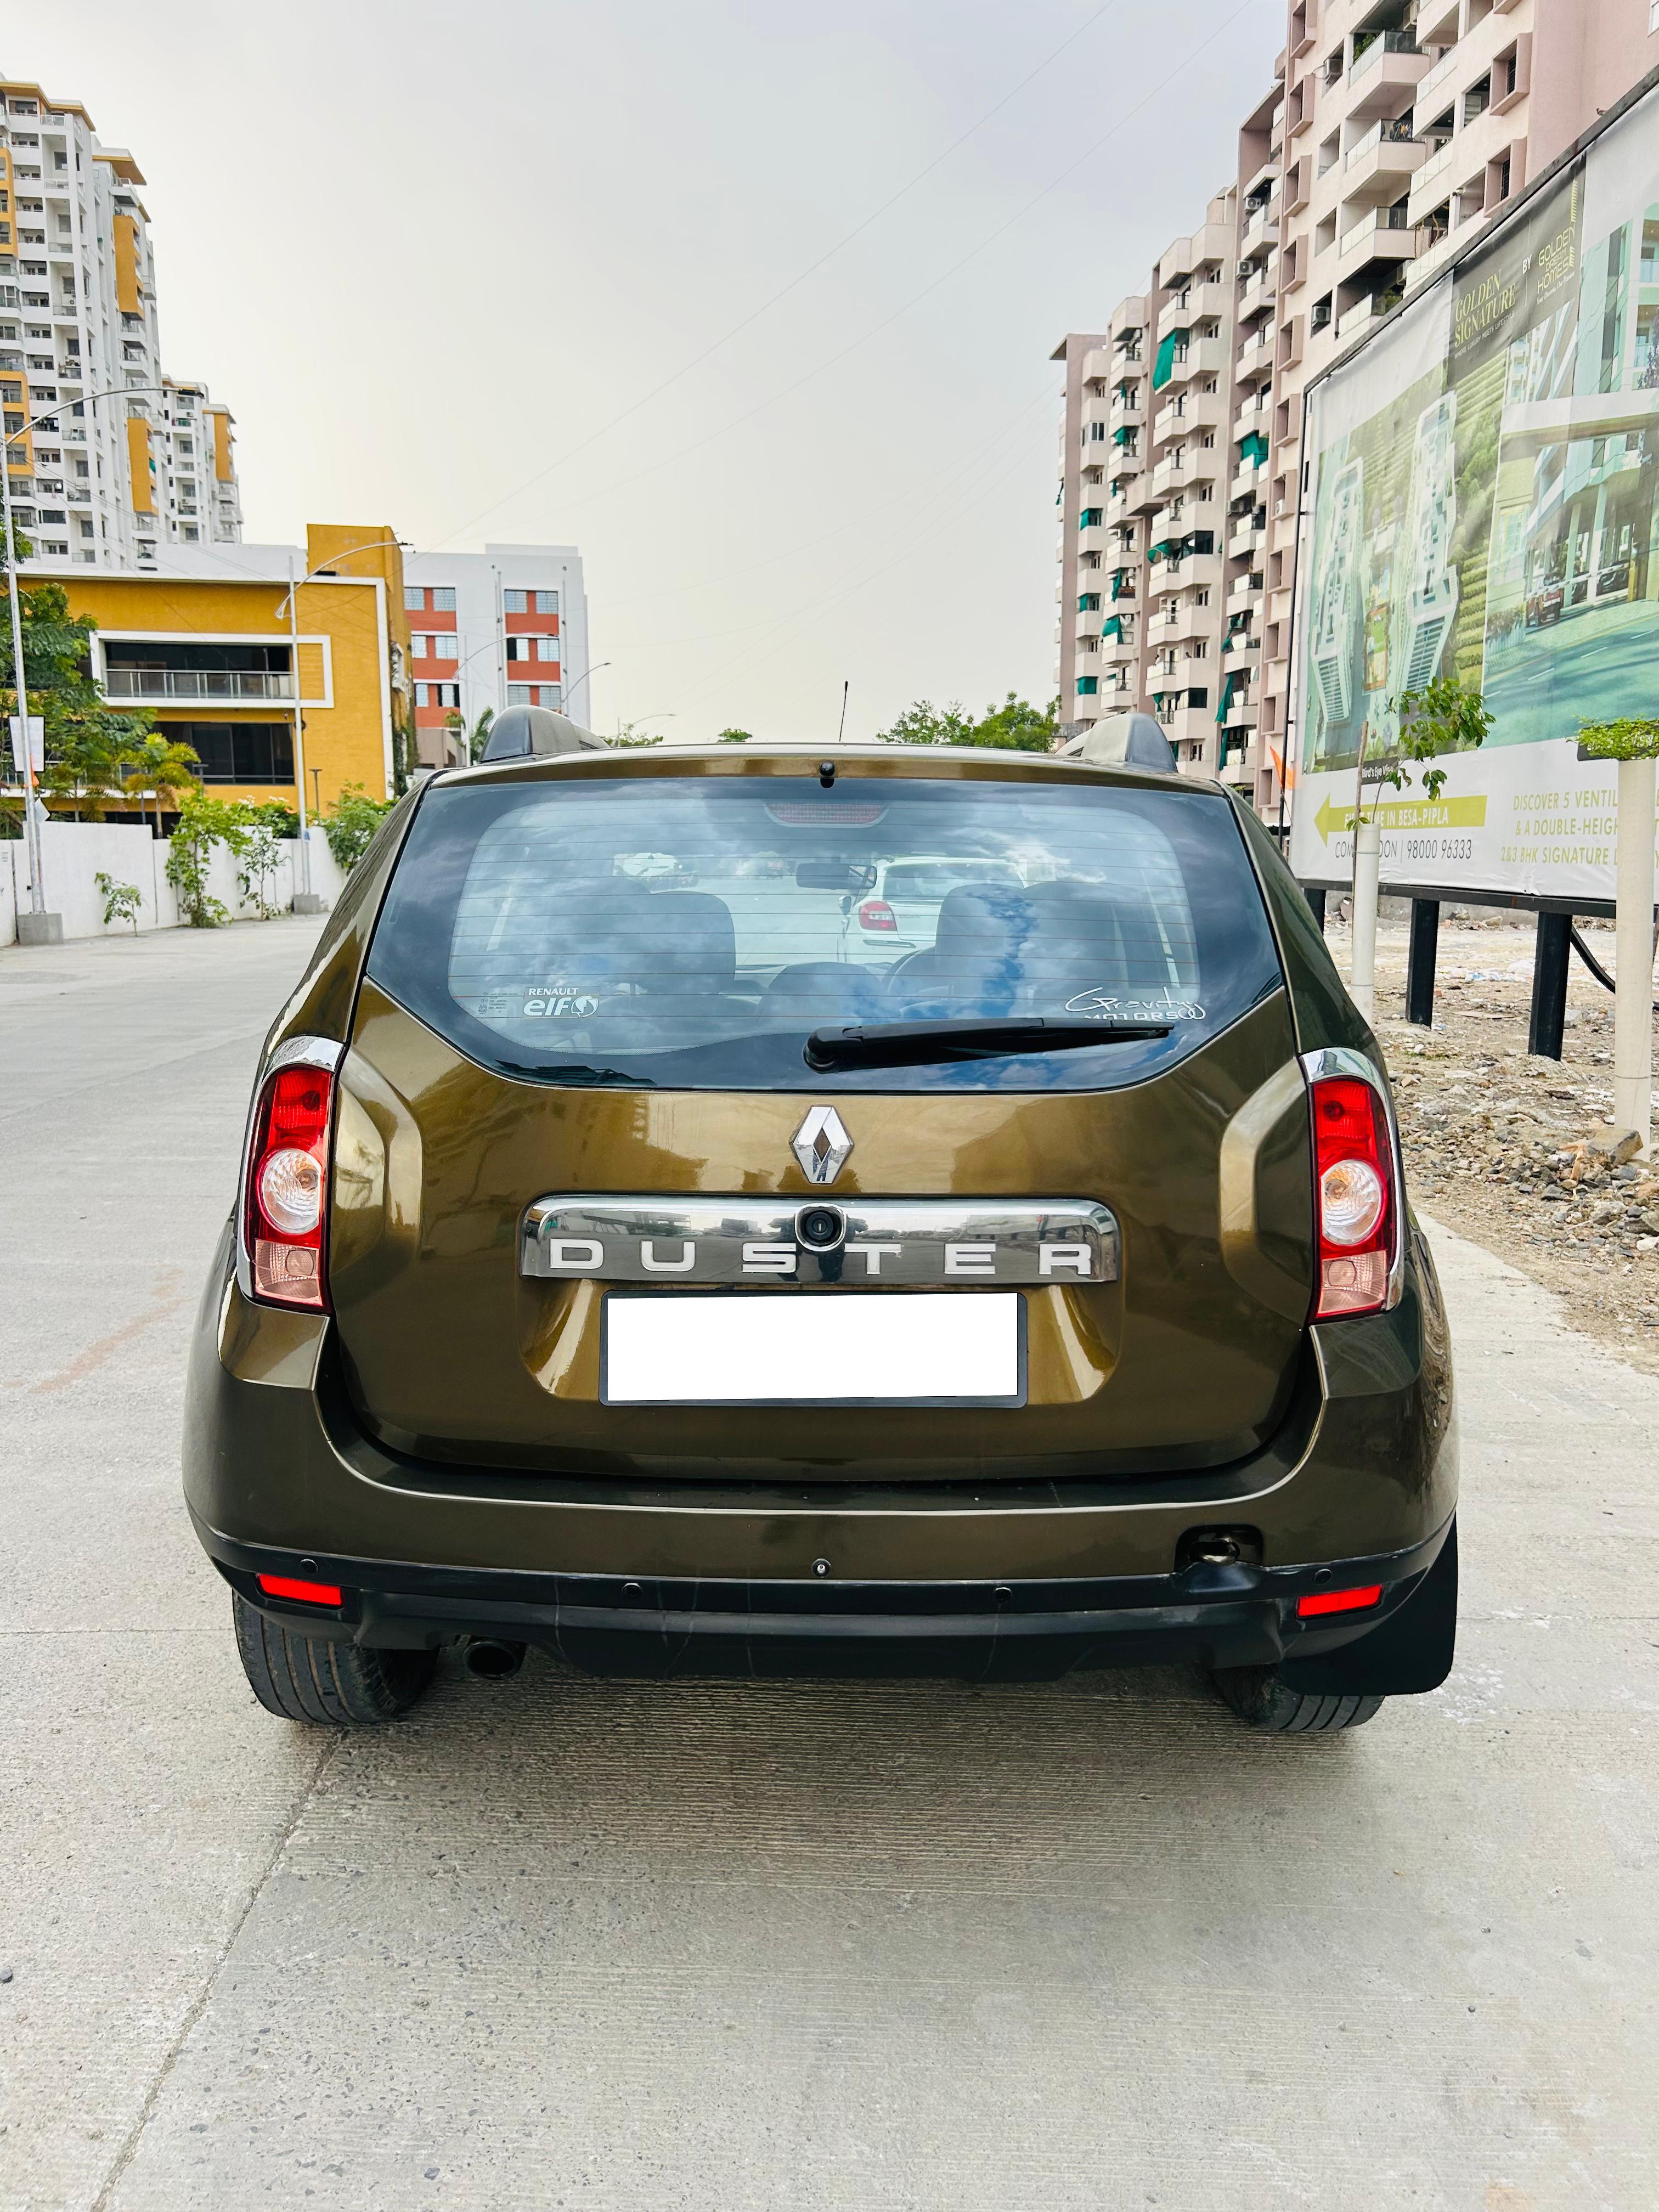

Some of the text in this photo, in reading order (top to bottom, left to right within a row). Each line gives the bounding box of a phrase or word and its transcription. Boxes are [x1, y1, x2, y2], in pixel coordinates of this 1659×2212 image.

[1538, 223, 1576, 267] GOLDEN
[1522, 254, 1532, 274] BY
[1537, 256, 1570, 295] HOMES
[1455, 268, 1502, 322] GOLDEN
[1454, 283, 1516, 348] SIGNATURE
[1481, 325, 1494, 340] MEETS
[1495, 310, 1515, 330] LIFESTYLE
[1513, 789, 1618, 811] DISCOVER 5 VENTIL
[1386, 809, 1396, 827] IN
[1398, 807, 1449, 827] BESA-PIPLA
[1515, 820, 1521, 836] &
[1524, 820, 1531, 836] A
[1407, 839, 1437, 860] 98000
[1441, 839, 1472, 860] 96333
[1501, 846, 1517, 863] 2&3
[1520, 847, 1538, 864] BHK
[1542, 847, 1609, 865] SIGNATURE
[528, 988, 579, 996] RENAULT
[523, 997, 572, 1016] elf
[549, 1238, 1093, 1276] DUSTER
